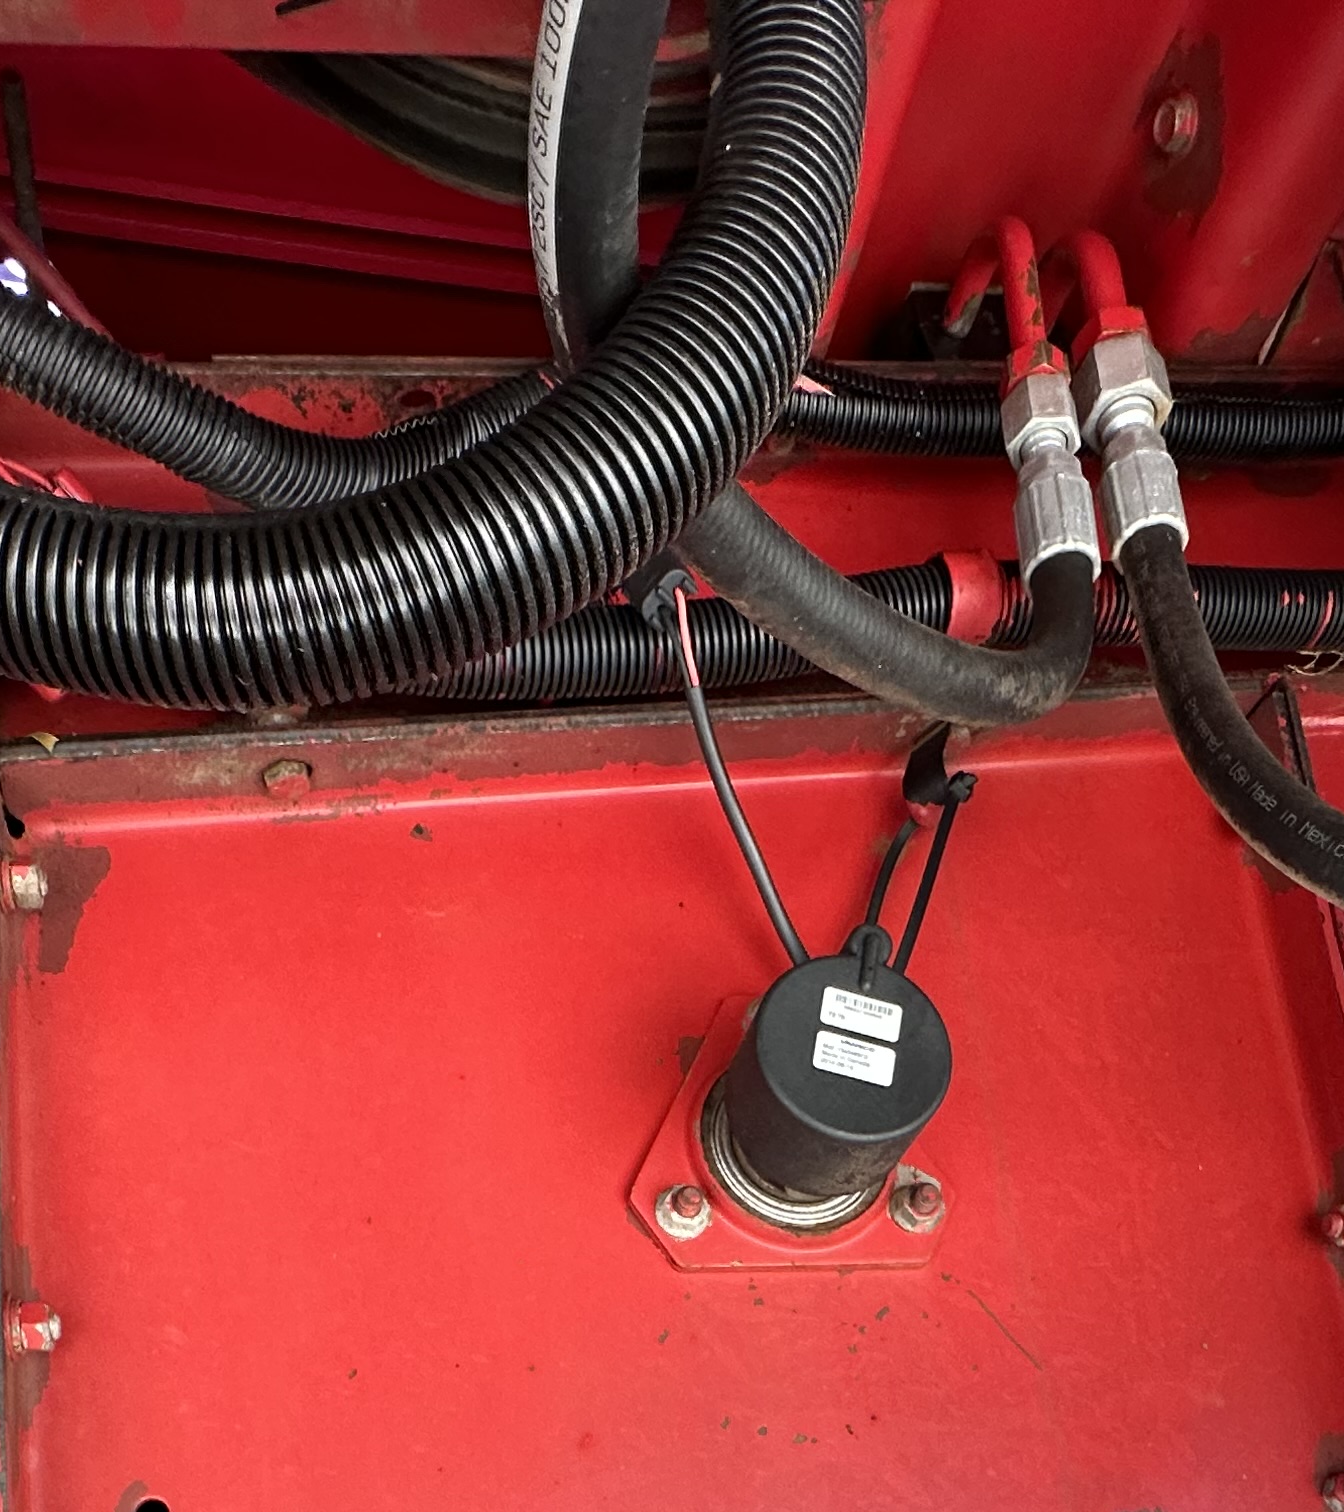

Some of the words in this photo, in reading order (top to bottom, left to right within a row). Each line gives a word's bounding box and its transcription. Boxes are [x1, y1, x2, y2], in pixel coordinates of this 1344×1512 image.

[539, 0, 570, 81] 100
[532, 79, 553, 158] SAE
[1246, 781, 1278, 813] Made
[1279, 809, 1298, 829] in
